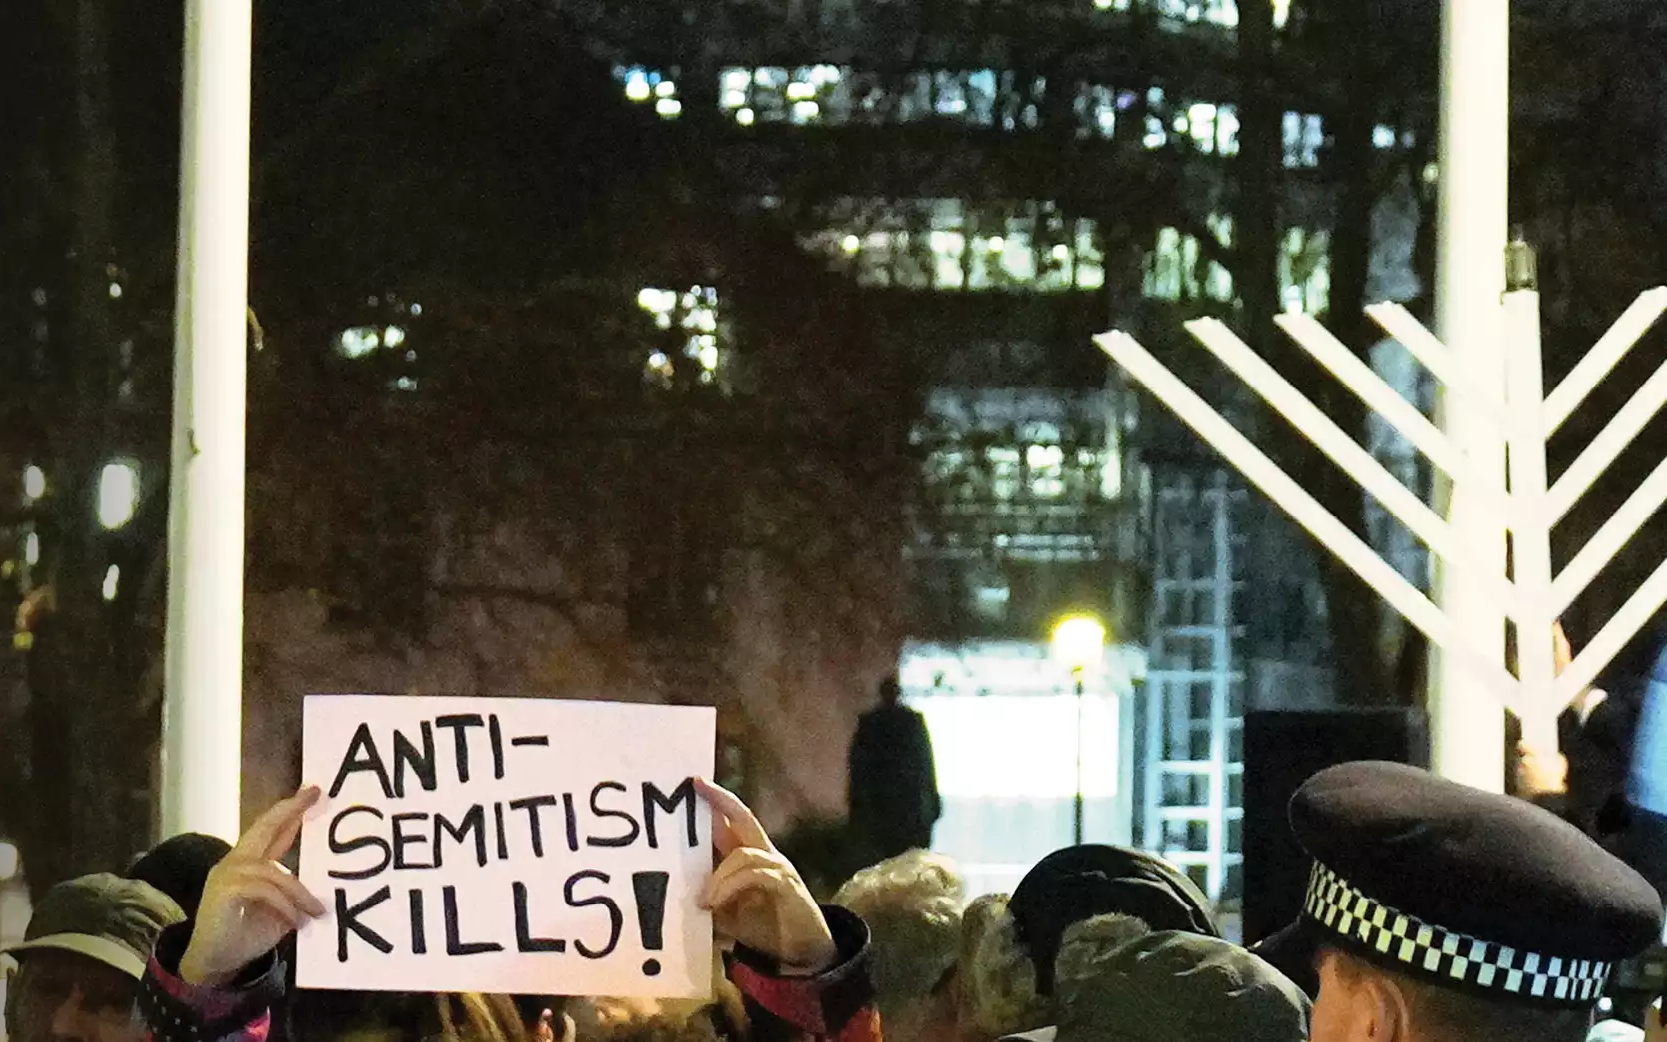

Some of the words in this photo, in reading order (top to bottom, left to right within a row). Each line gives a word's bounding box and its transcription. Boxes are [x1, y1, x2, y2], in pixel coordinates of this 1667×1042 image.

[328, 713, 549, 798] ANTI-
[328, 776, 699, 880] SEMITISM
[334, 868, 670, 977] KILLS!
